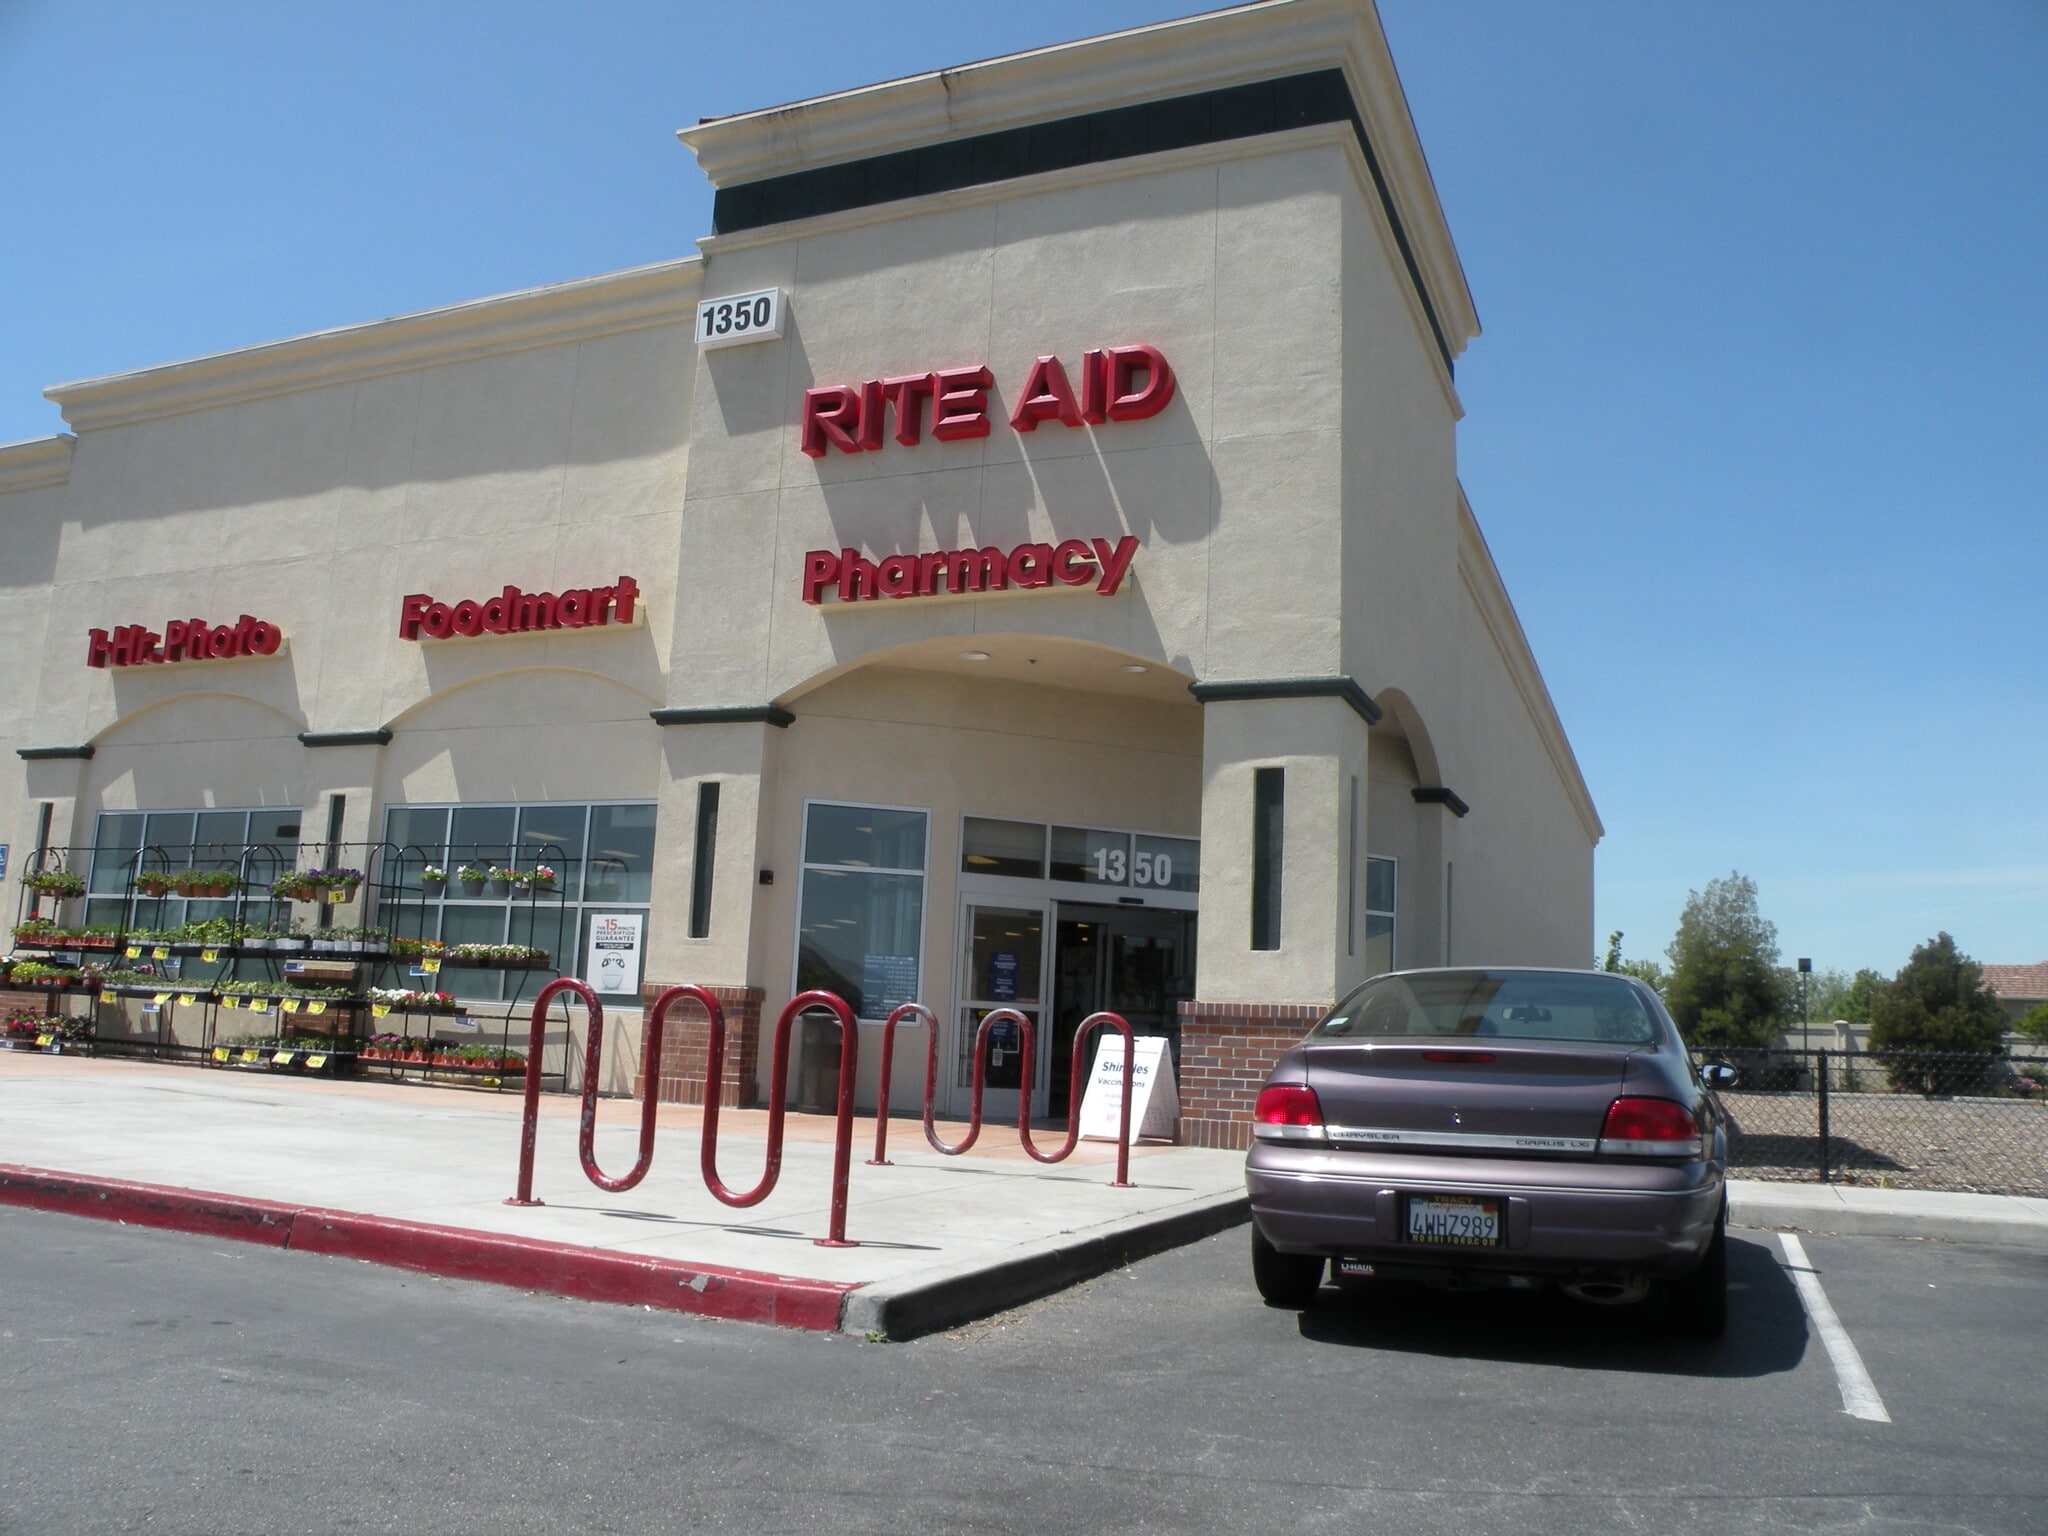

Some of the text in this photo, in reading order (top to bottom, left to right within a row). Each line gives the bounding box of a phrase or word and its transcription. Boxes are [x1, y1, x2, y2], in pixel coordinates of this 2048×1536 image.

[702, 296, 771, 336] 1350
[801, 344, 1176, 458] RITE AID
[802, 535, 1140, 605] Pharmacy
[399, 576, 640, 641] Foodmart
[163, 614, 282, 663] Photo
[1093, 848, 1172, 886] 1350
[605, 919, 618, 931] 15
[1098, 1077, 1145, 1088] Vaccinons
[1102, 1061, 1149, 1075] Shinles
[1333, 1131, 1400, 1140] CHRYSLER
[1413, 1212, 1495, 1238] 4WHZ989
[1341, 1263, 1374, 1272] U-HAUL
